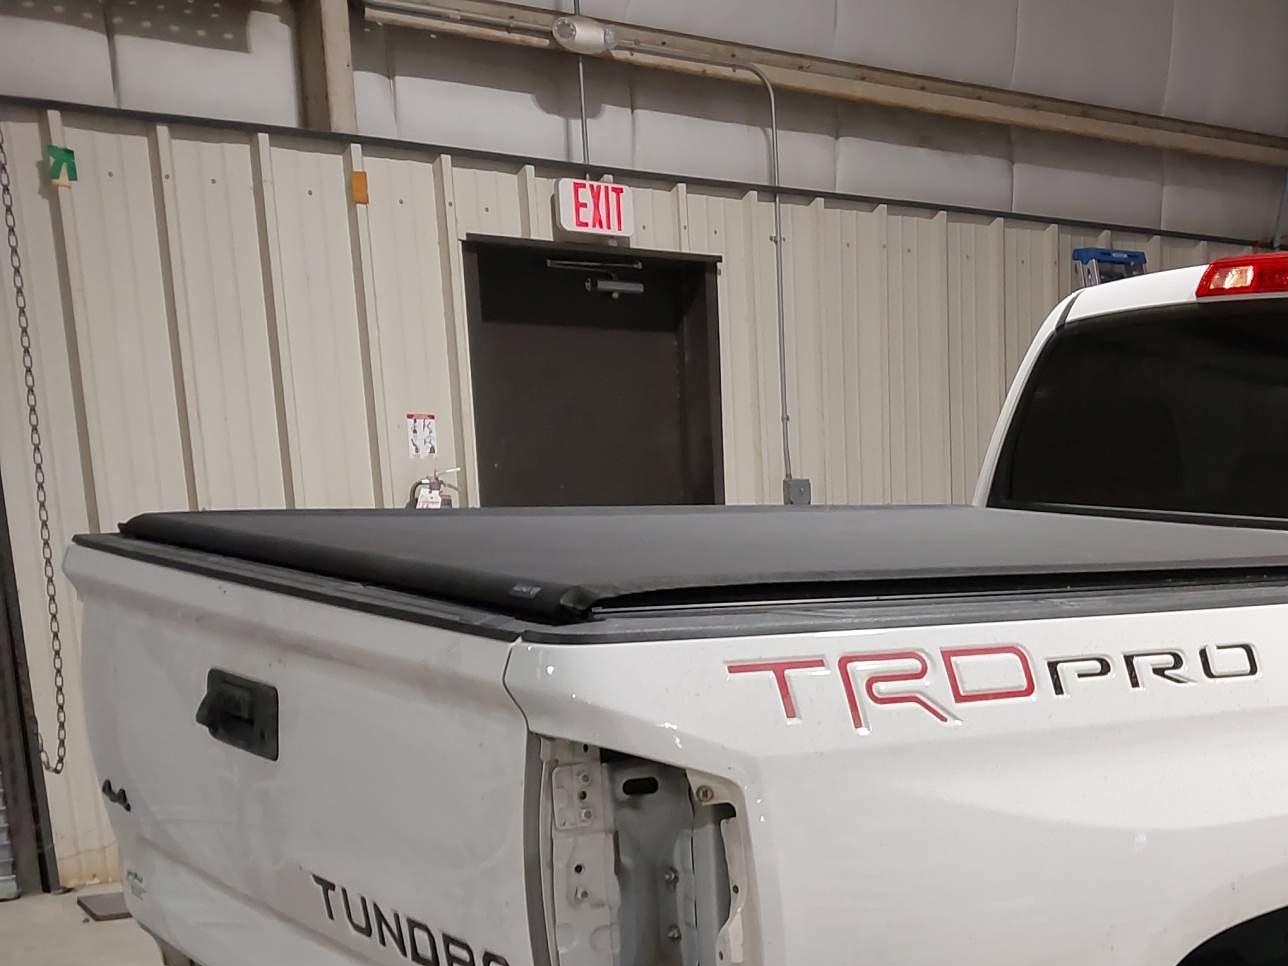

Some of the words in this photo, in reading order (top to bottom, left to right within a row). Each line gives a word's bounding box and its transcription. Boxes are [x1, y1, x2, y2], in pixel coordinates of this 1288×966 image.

[573, 181, 625, 232] EXIT
[725, 645, 1036, 734] TRD
[1046, 643, 1259, 697] PRO
